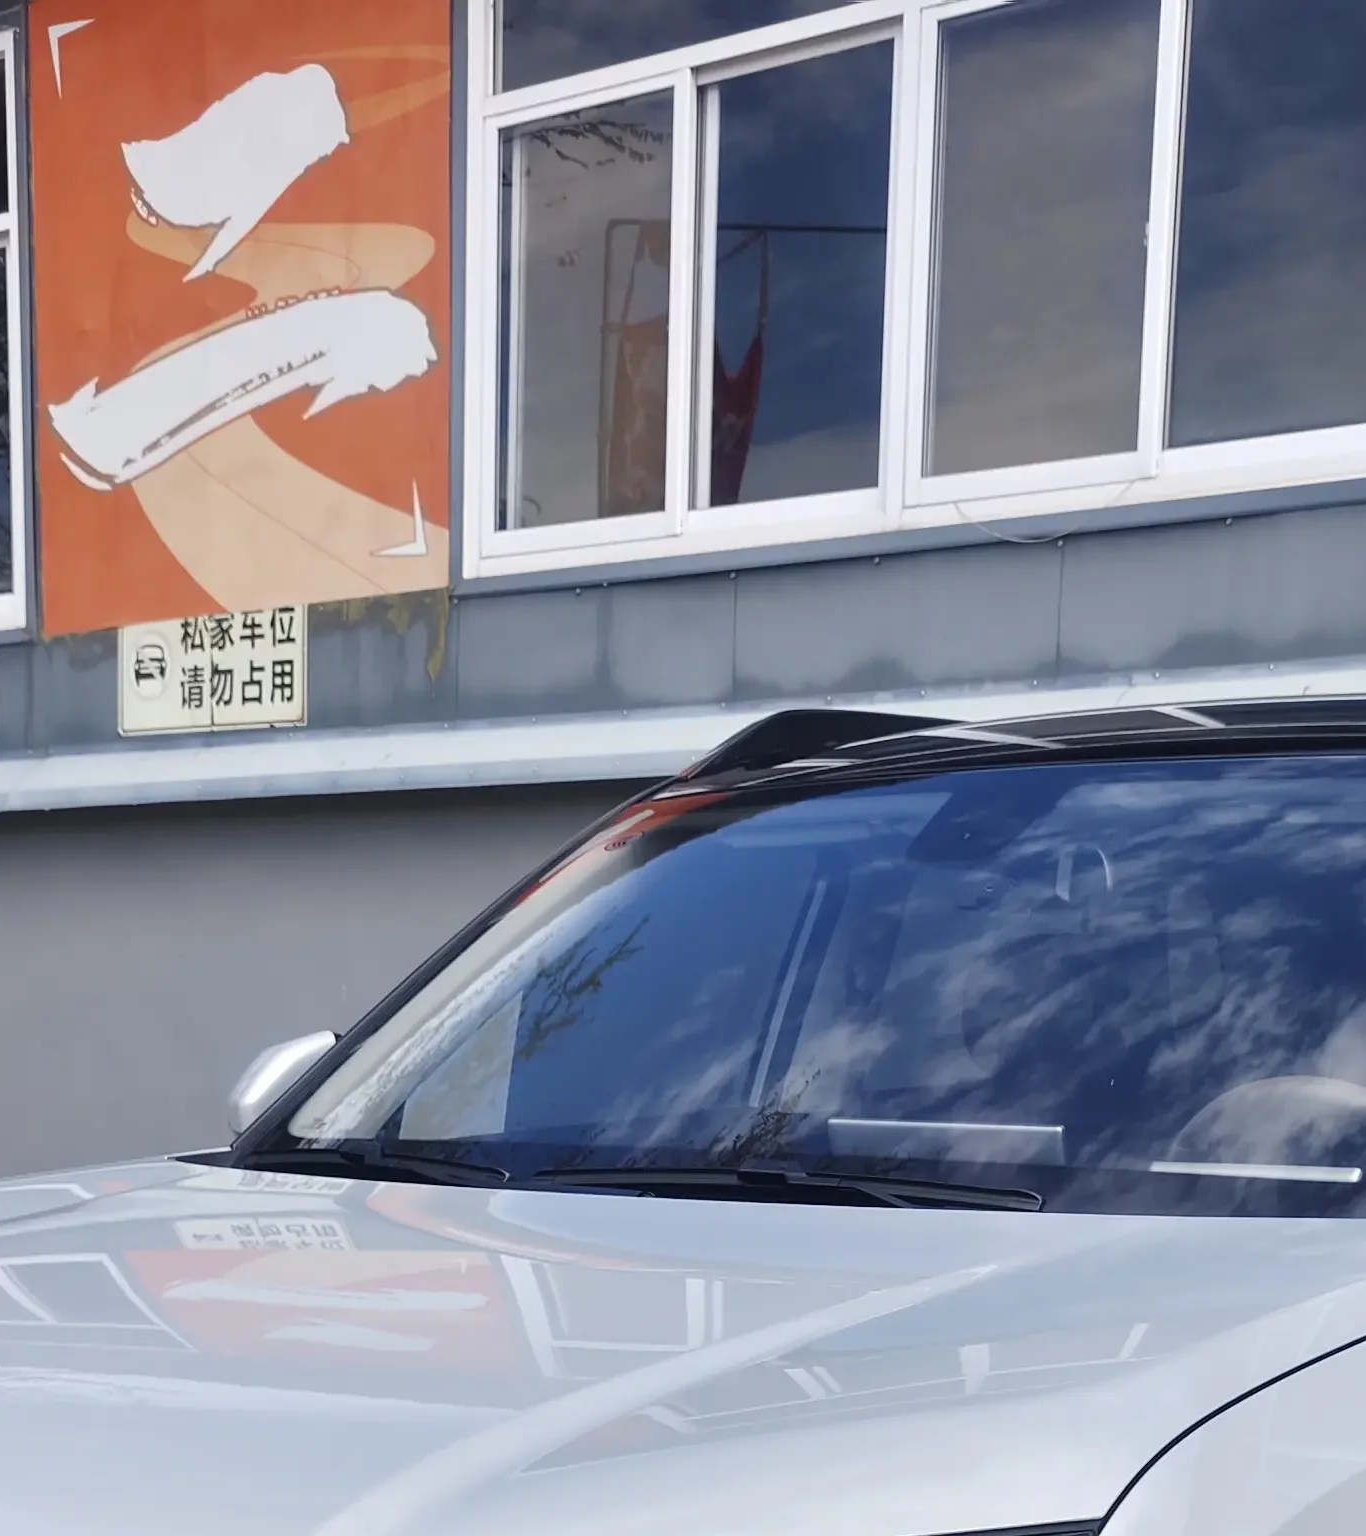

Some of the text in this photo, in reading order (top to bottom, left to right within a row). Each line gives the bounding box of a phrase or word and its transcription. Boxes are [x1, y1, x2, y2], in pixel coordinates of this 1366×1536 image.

[180, 606, 296, 654] 私家车位
[180, 659, 295, 710] 请勿占用
